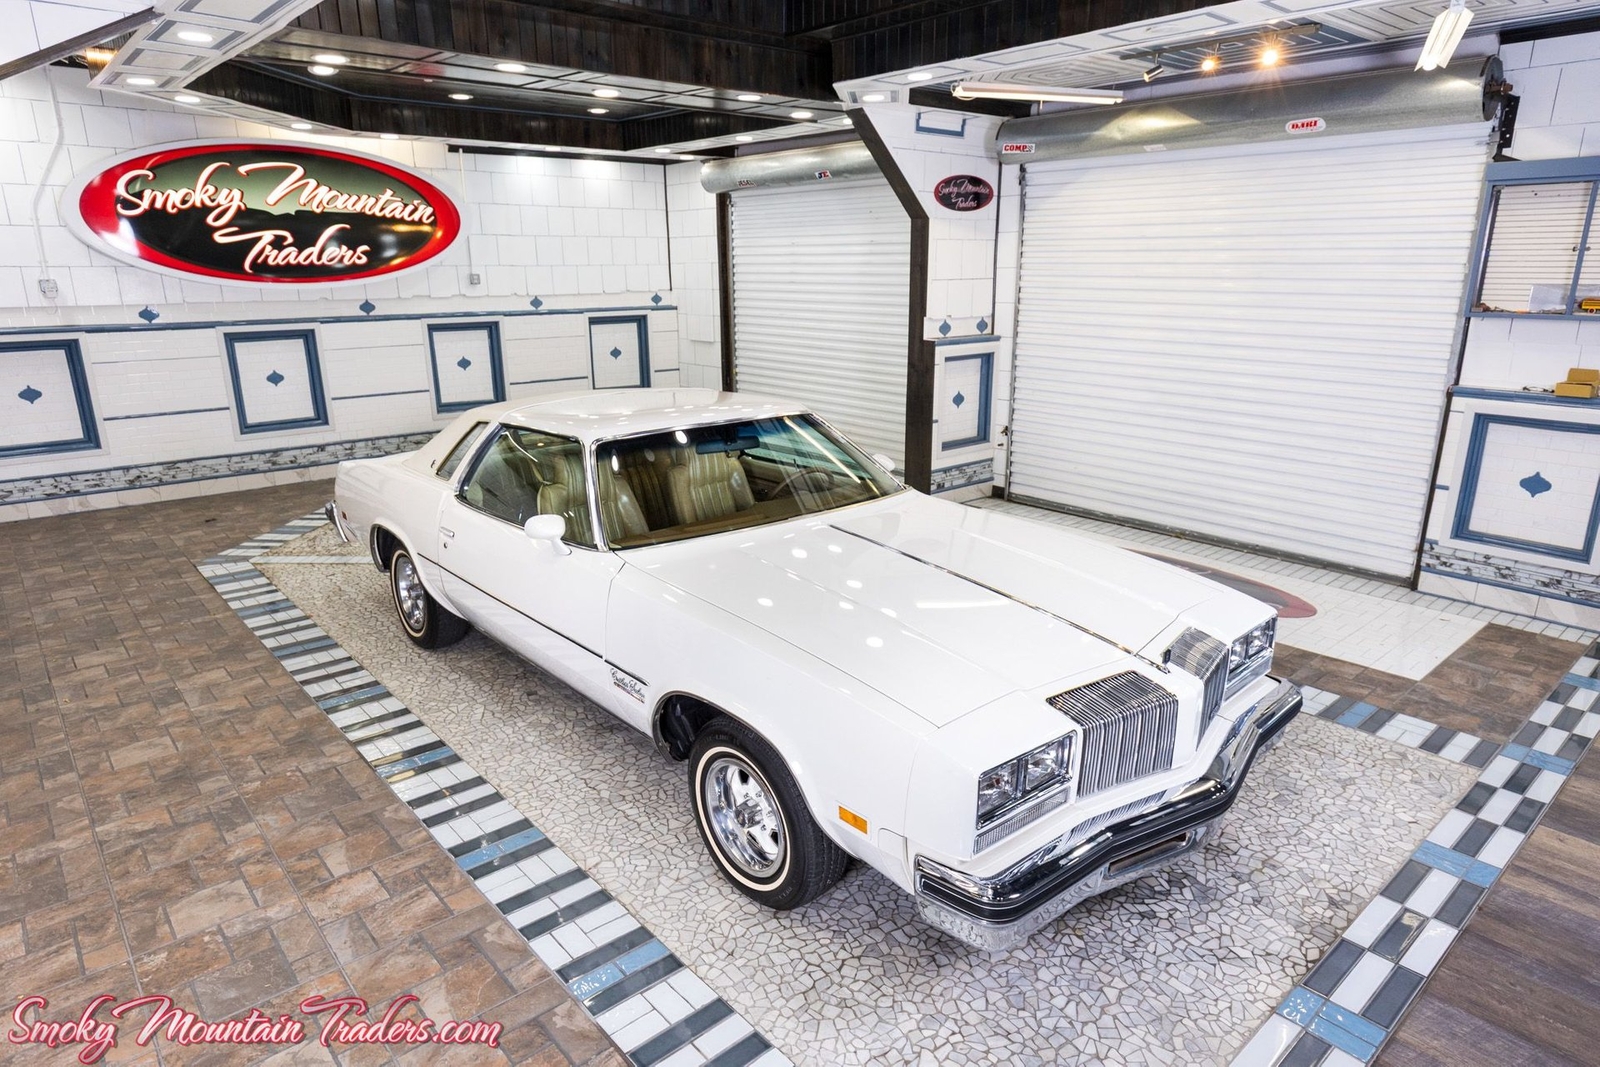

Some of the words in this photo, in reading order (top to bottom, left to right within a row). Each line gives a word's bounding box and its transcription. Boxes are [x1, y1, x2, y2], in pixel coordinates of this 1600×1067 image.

[116, 161, 247, 228] Smoky
[237, 161, 436, 224] Mountain
[212, 223, 371, 275] Traders
